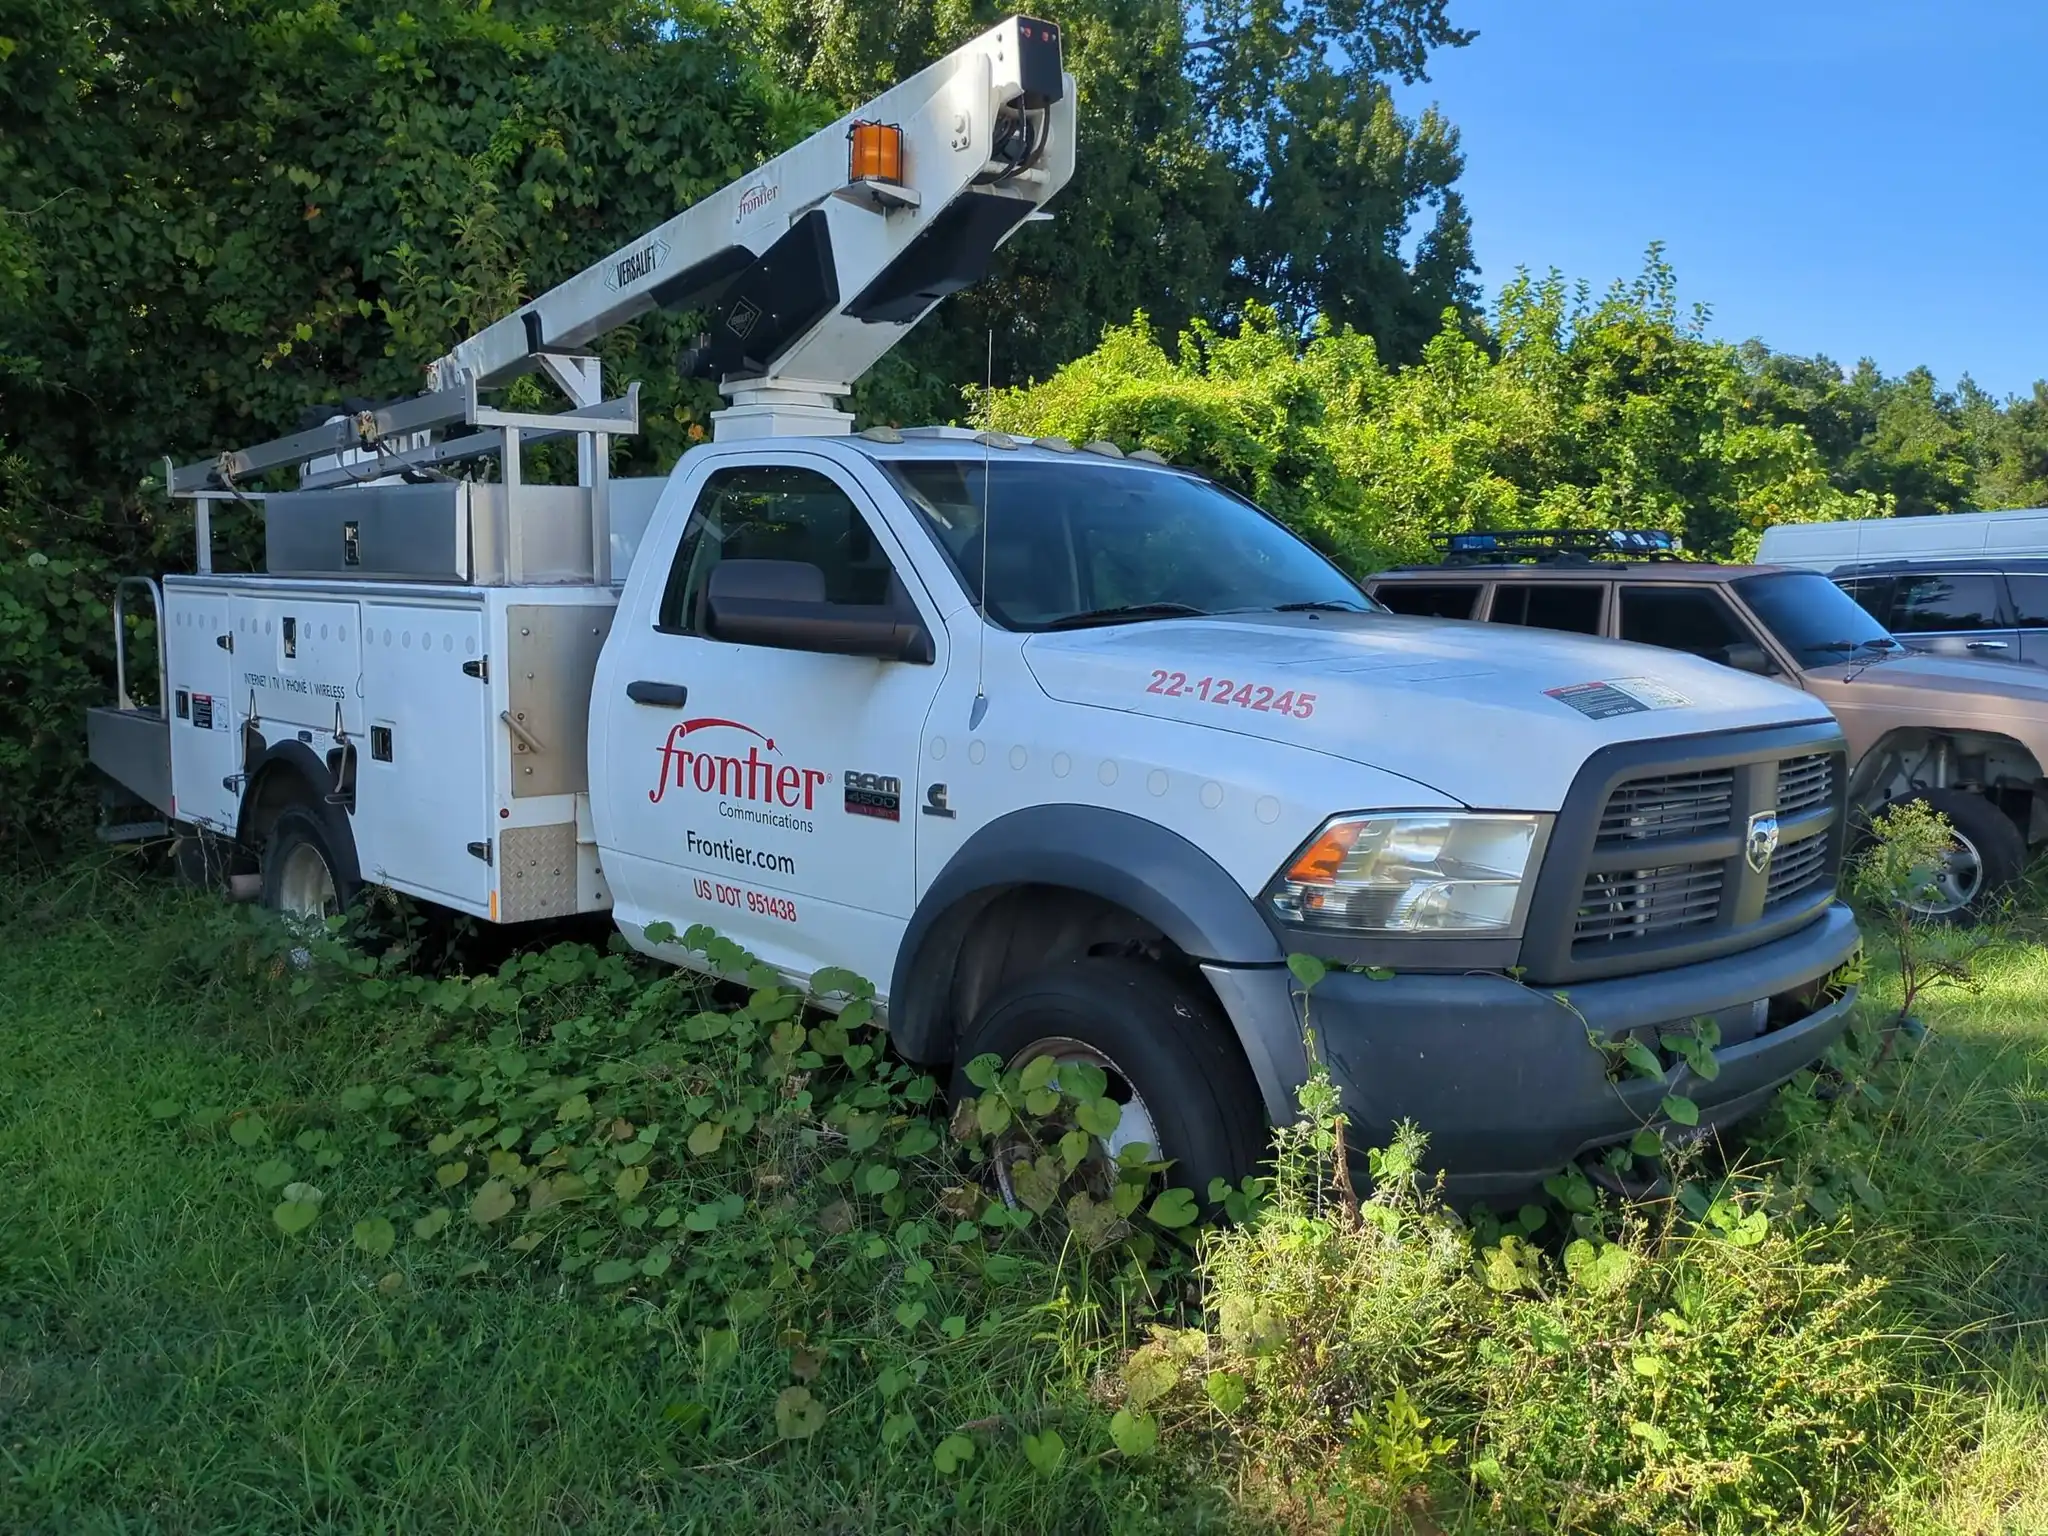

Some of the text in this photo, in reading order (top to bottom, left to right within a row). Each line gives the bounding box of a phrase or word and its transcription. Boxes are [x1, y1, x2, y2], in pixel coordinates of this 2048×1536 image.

[736, 184, 779, 224] frontier
[616, 245, 657, 288] VERSALIFT
[244, 673, 346, 699] INTERNET TV PHONE WIRELESS
[1146, 669, 1317, 719] 22-124245
[649, 724, 825, 811] frontier
[844, 770, 901, 795] RAM
[718, 801, 814, 833] Communications
[847, 791, 897, 809] 4500
[686, 830, 795, 875] Frontier.com
[693, 878, 797, 922] US DOT 951438
